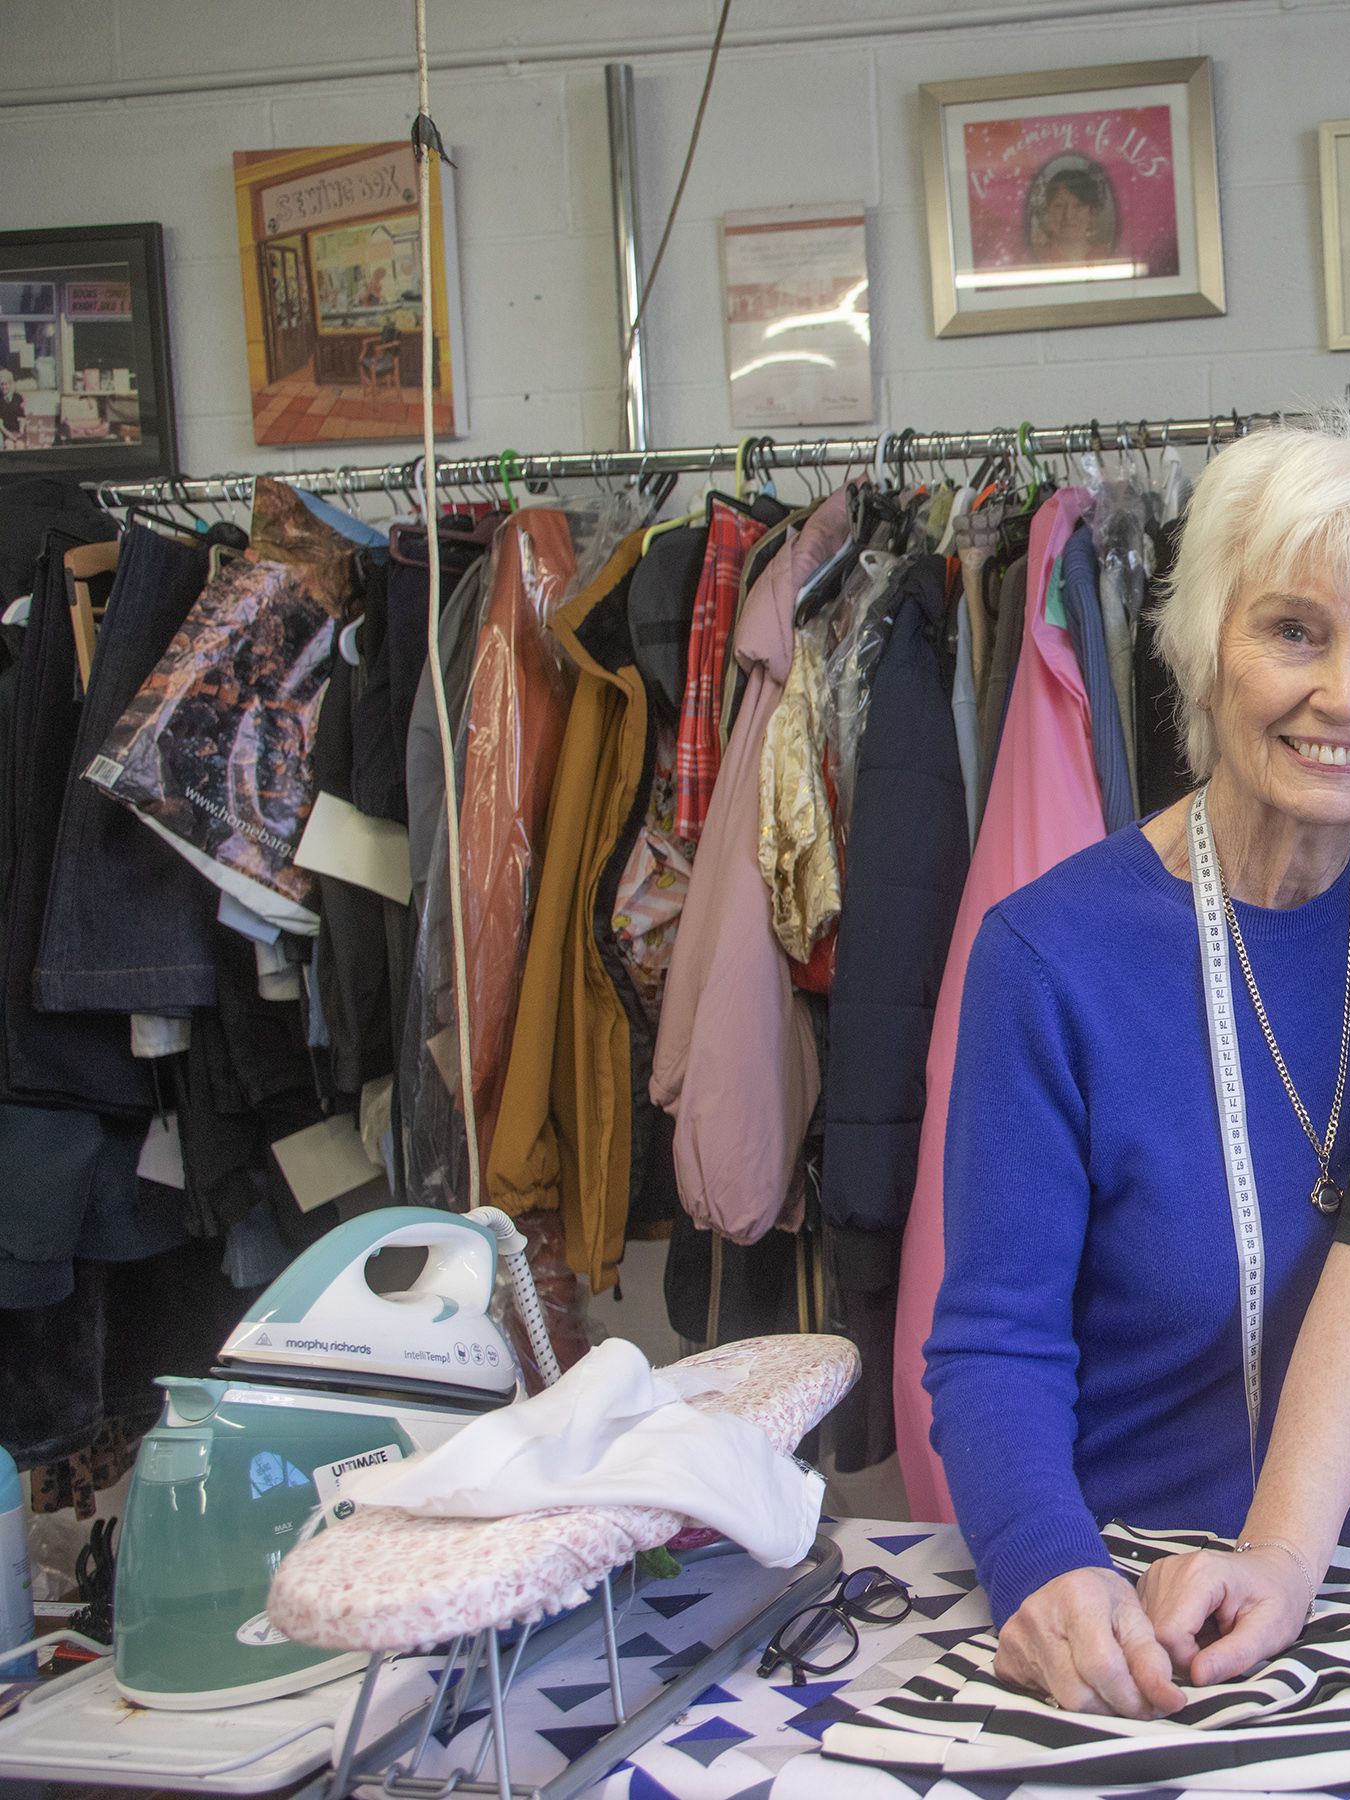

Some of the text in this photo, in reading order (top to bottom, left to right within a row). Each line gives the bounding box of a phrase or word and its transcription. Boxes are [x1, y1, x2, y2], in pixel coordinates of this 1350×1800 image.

[1195, 813, 1201, 821] 90
[1196, 826, 1203, 835] 89
[1199, 841, 1206, 849] 88
[1201, 855, 1208, 863] 87
[1202, 869, 1210, 877] 86
[1204, 883, 1212, 892] 85
[1208, 913, 1216, 921] 83
[1210, 928, 1218, 936] 82
[1212, 943, 1220, 951] 81
[1214, 959, 1221, 967] 80
[1215, 974, 1222, 982] 79
[1216, 990, 1224, 998] 78
[1220, 1021, 1227, 1029] 76
[1221, 1036, 1229, 1045] 75
[1223, 1052, 1231, 1060] 74
[1225, 1068, 1233, 1076] 73
[1227, 1083, 1235, 1092] 72
[1230, 1099, 1237, 1107] 71
[1231, 1114, 1238, 1123] 70
[1232, 1130, 1240, 1138] 69
[1234, 1146, 1241, 1154] 68
[1237, 1161, 1244, 1170] 67
[1238, 1177, 1246, 1186] 66
[1241, 1192, 1248, 1201] 65
[1243, 1208, 1250, 1217] 64
[1245, 1224, 1252, 1233] 63
[1247, 1240, 1255, 1249] 62
[1250, 1256, 1256, 1264] 61
[1250, 1271, 1256, 1280] 60
[1250, 1286, 1256, 1295] 59
[1250, 1302, 1256, 1310] 58
[286, 1339, 372, 1355] morphy richards
[274, 1522, 294, 1532] MAX
